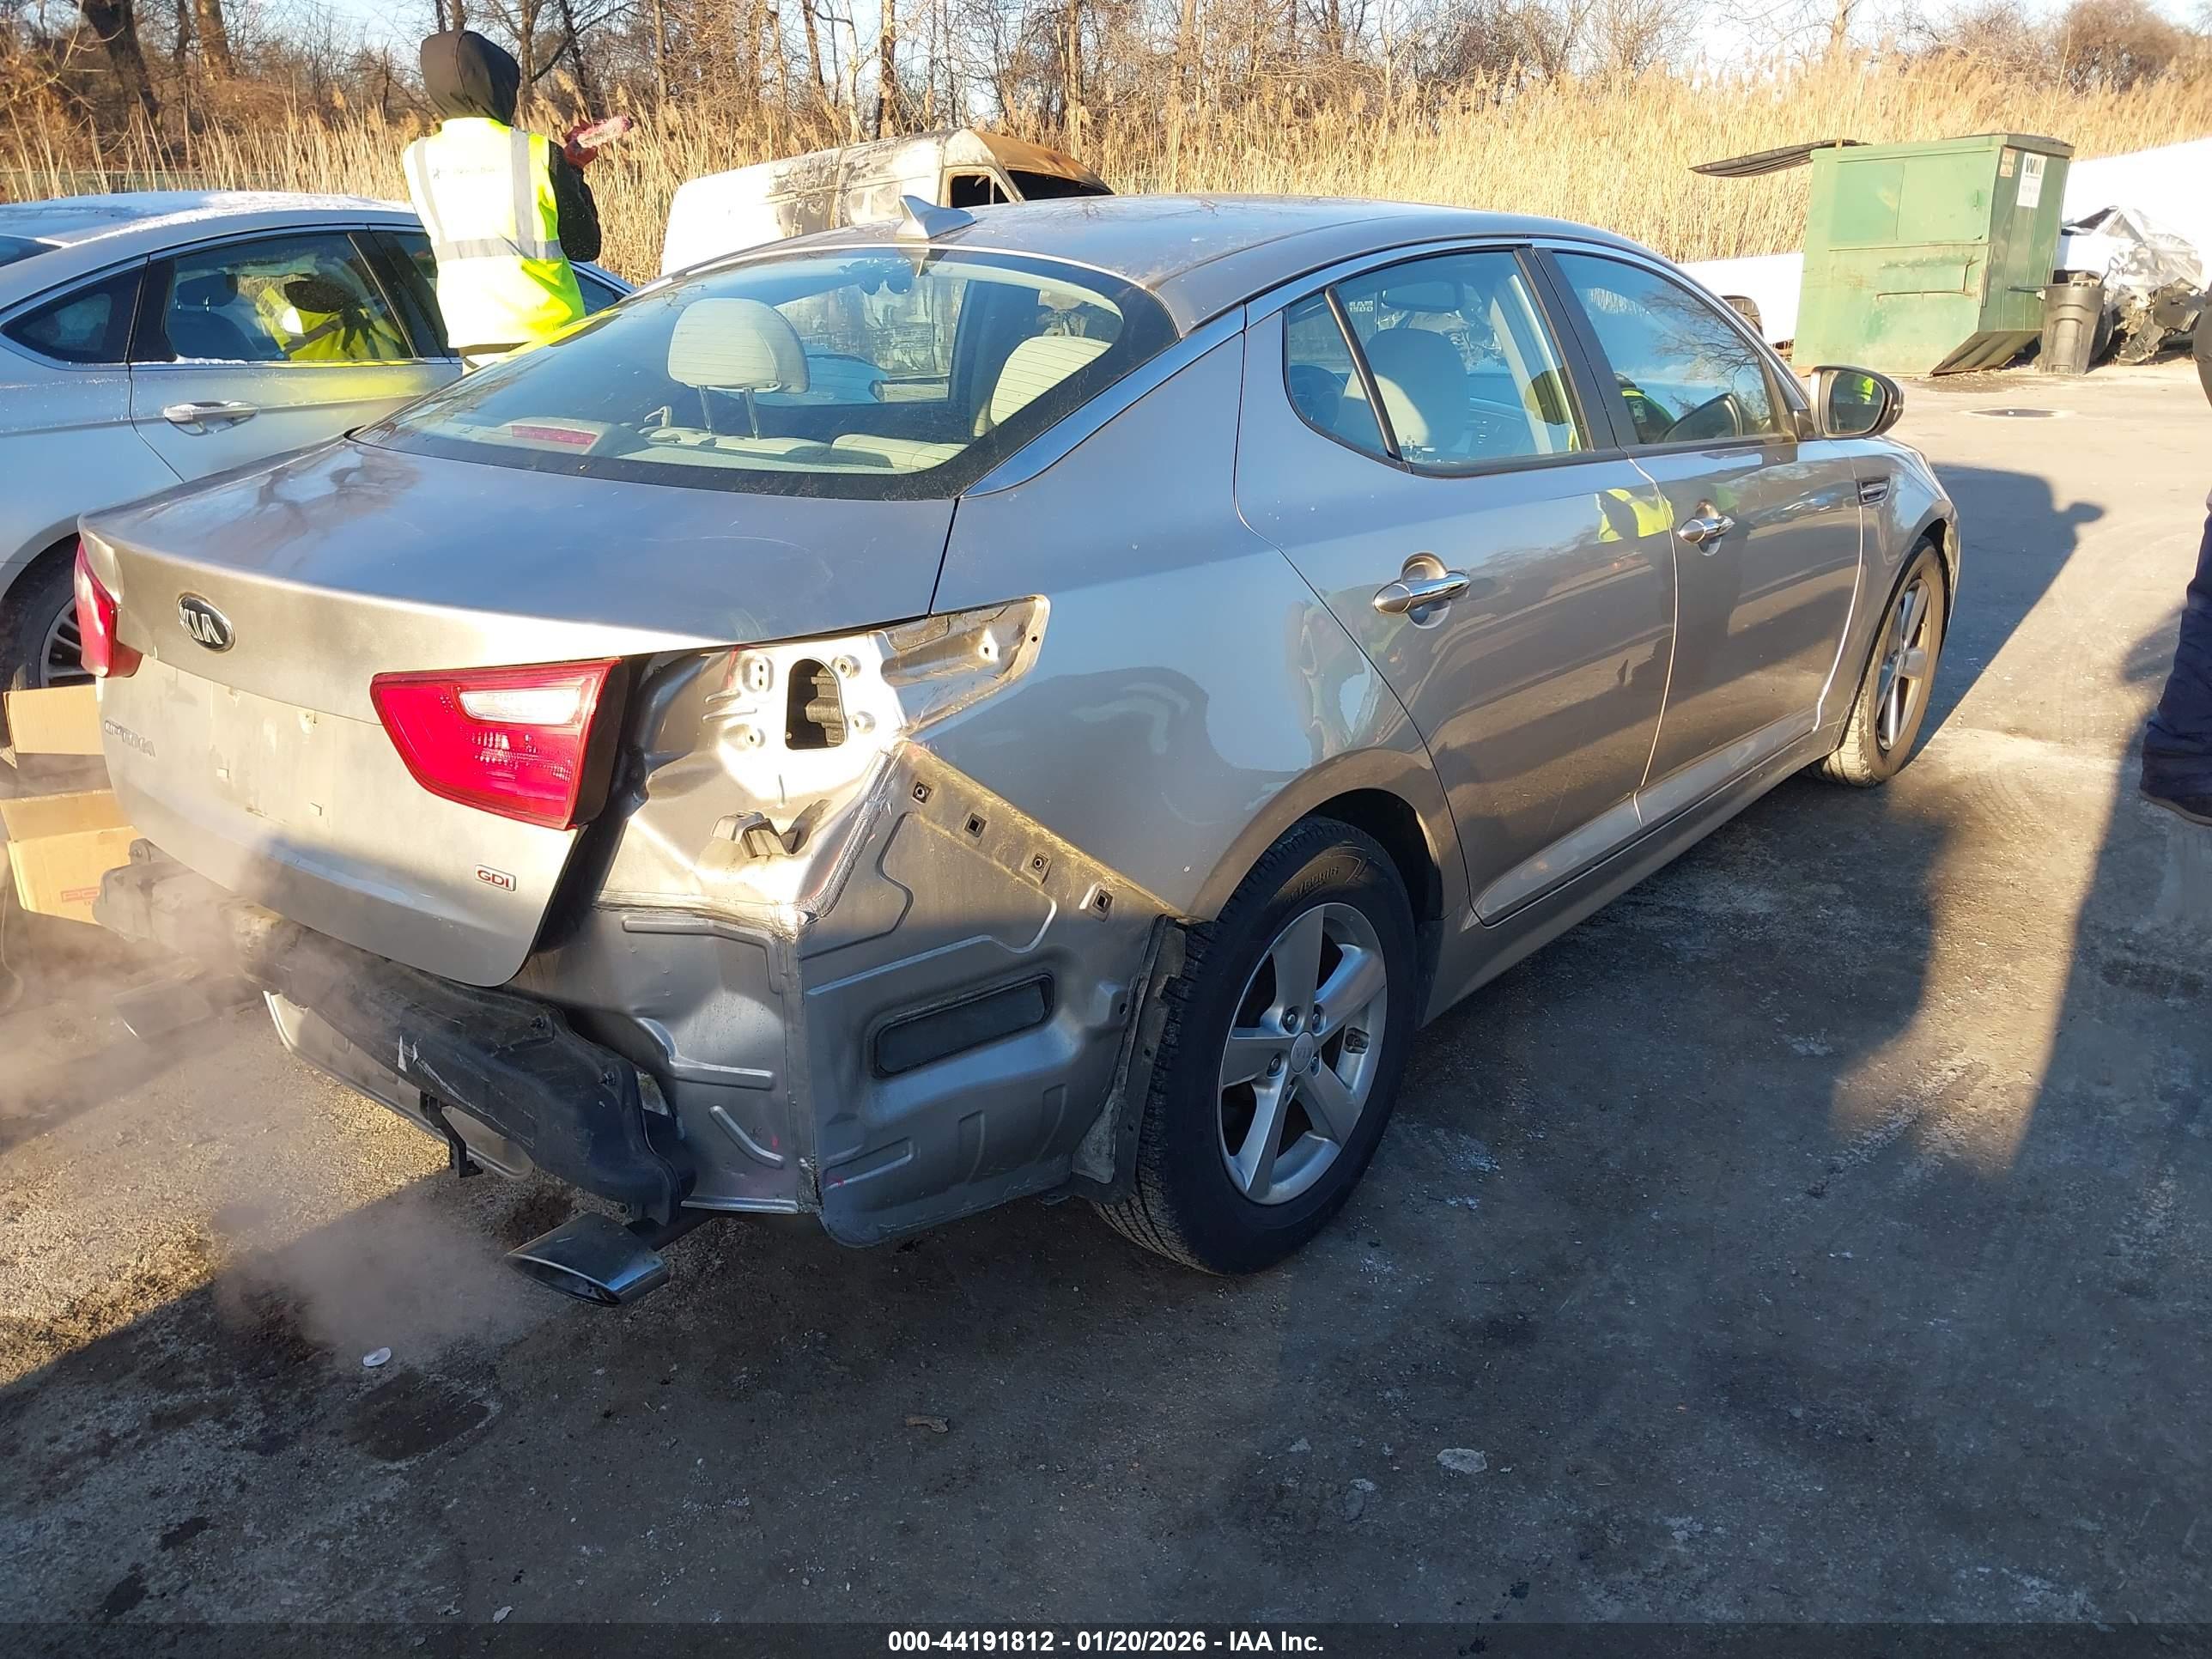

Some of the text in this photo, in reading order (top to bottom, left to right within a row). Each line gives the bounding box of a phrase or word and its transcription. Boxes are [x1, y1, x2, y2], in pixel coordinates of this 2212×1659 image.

[2026, 157, 2043, 175] WM
[179, 604, 224, 644] KIA
[477, 870, 509, 888] GDI
